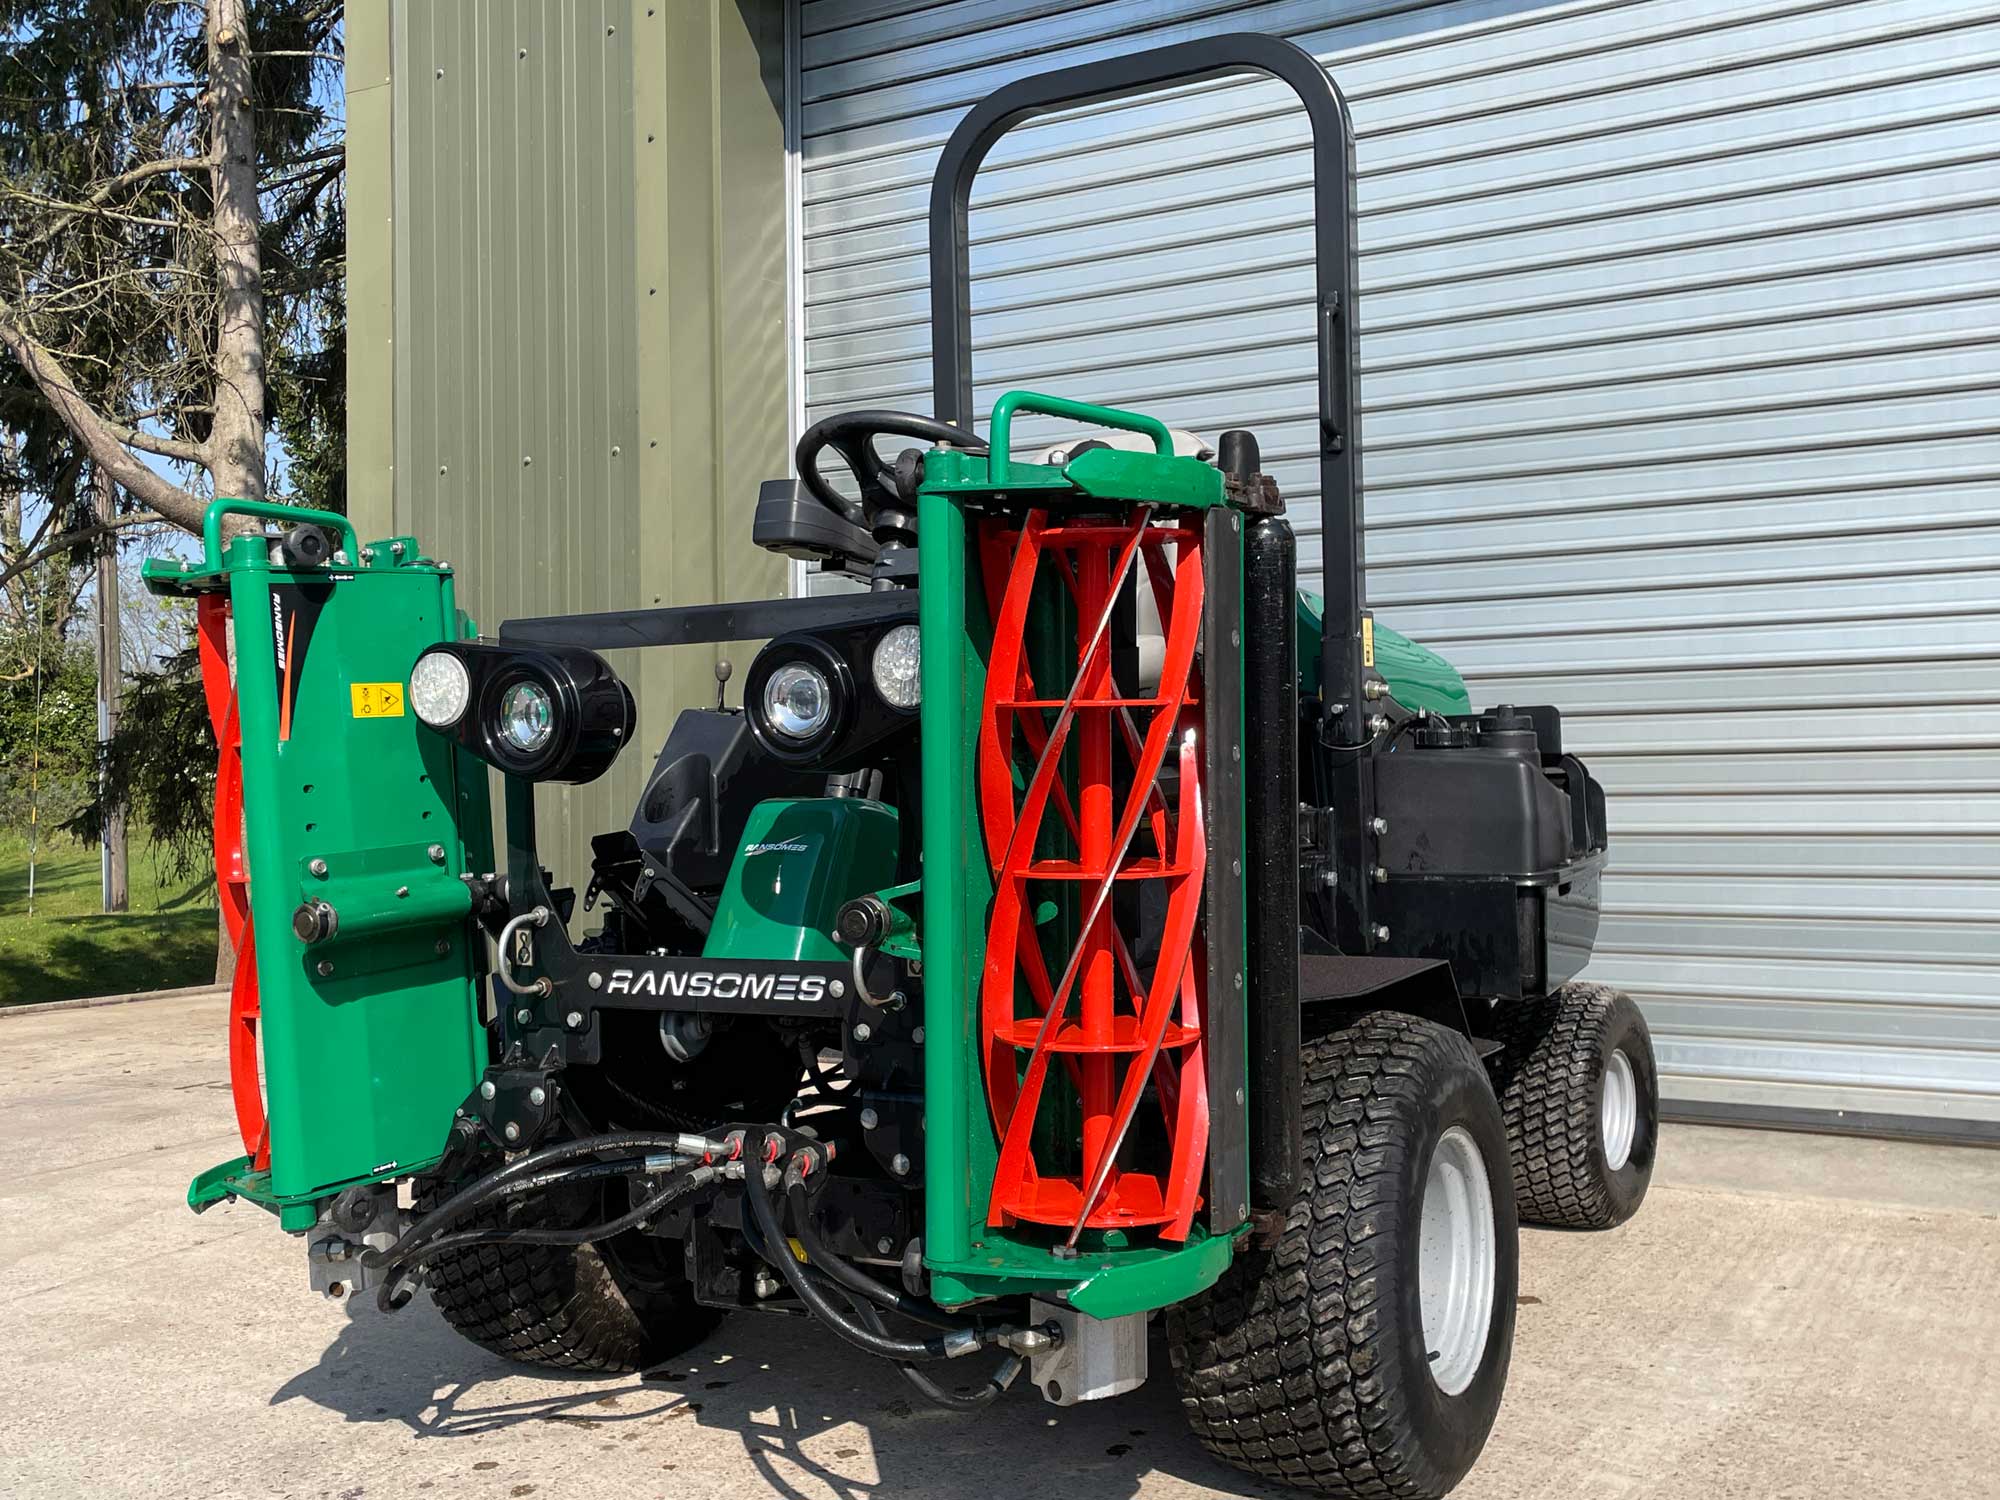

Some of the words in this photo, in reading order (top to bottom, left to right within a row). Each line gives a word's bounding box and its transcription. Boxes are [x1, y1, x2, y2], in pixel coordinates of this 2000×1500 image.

[273, 592, 286, 671] RANSOMES
[745, 843, 808, 852] RANSOMES
[607, 969, 827, 1001] RANSOMES
